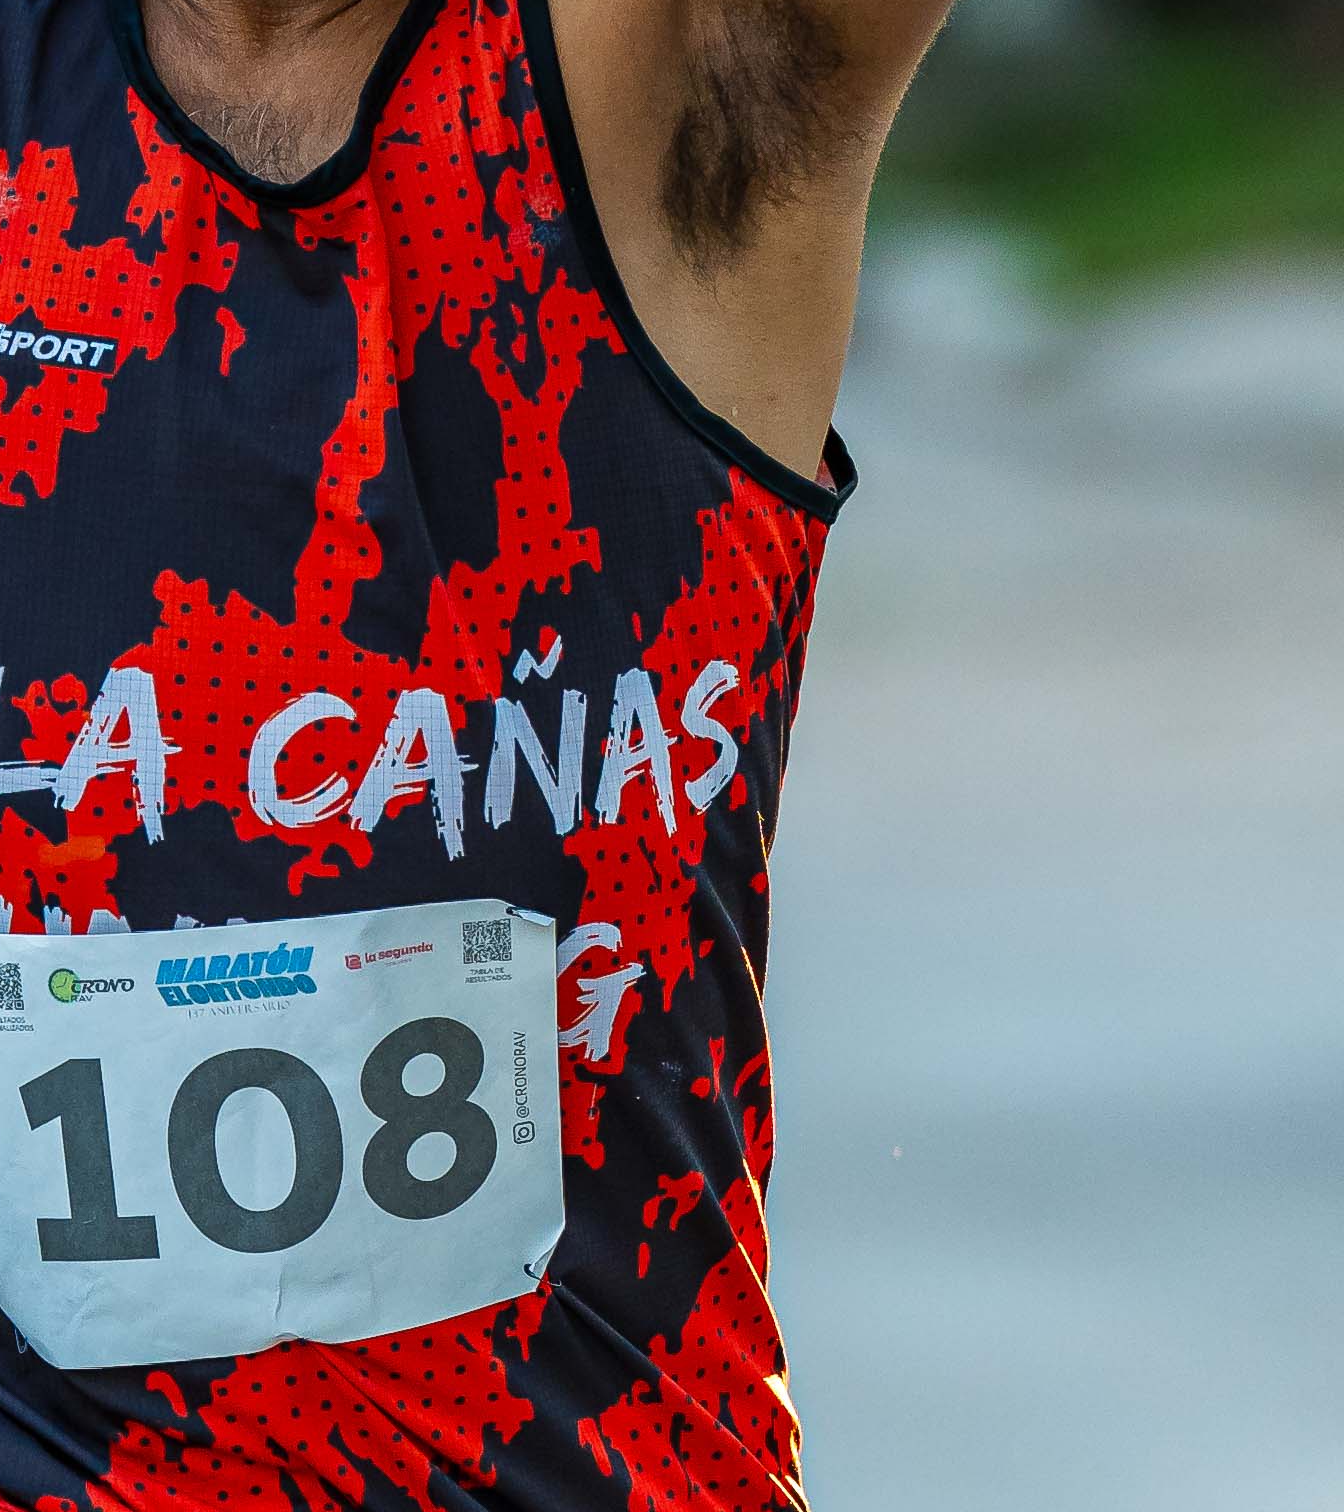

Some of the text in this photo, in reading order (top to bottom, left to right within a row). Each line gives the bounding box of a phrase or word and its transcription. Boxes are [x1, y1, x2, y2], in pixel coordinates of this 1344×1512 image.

[248, 635, 740, 862] CAÑAS
[155, 942, 314, 984] MARATÓN
[364, 952, 377, 964] la
[378, 941, 434, 960] segunda
[513, 1031, 530, 1119] @CRONORAV
[19, 1017, 498, 1262] 108
